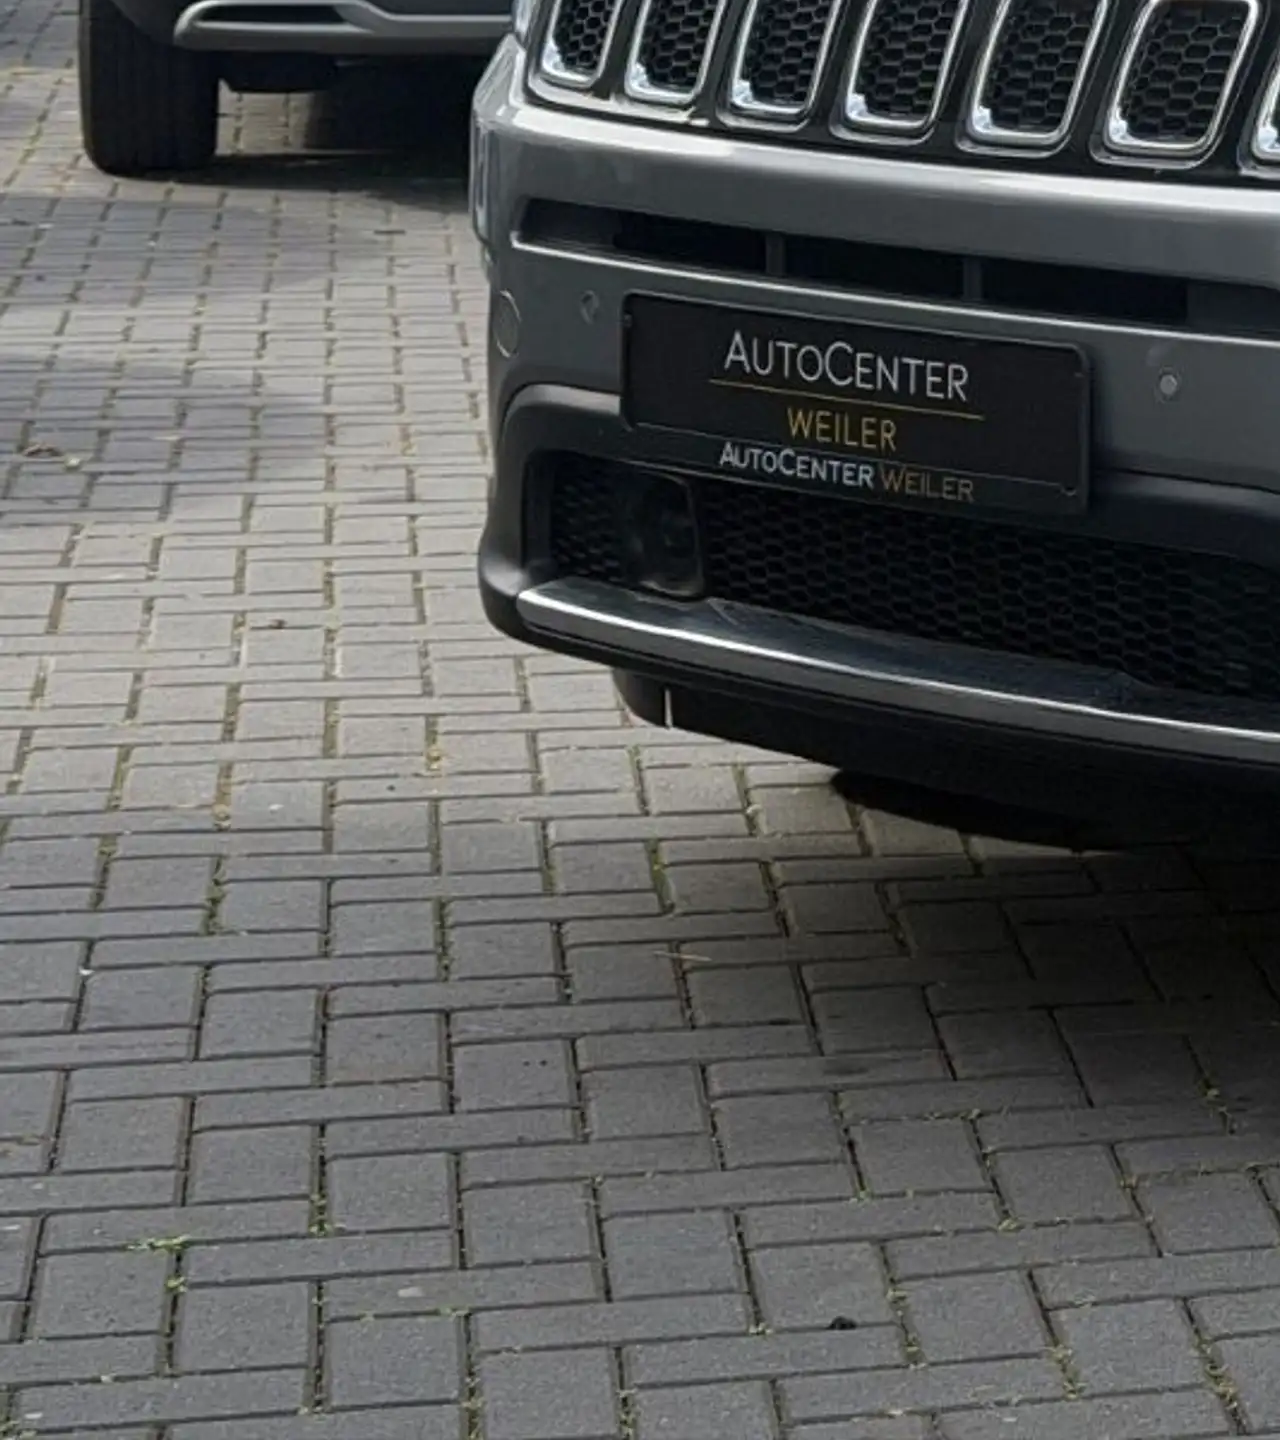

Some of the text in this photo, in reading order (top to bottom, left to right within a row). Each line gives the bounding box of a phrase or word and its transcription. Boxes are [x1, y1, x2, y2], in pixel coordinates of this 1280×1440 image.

[724, 329, 969, 402] AUTOCENTER
[787, 407, 897, 452] WEILER
[876, 463, 975, 503] WEILER
